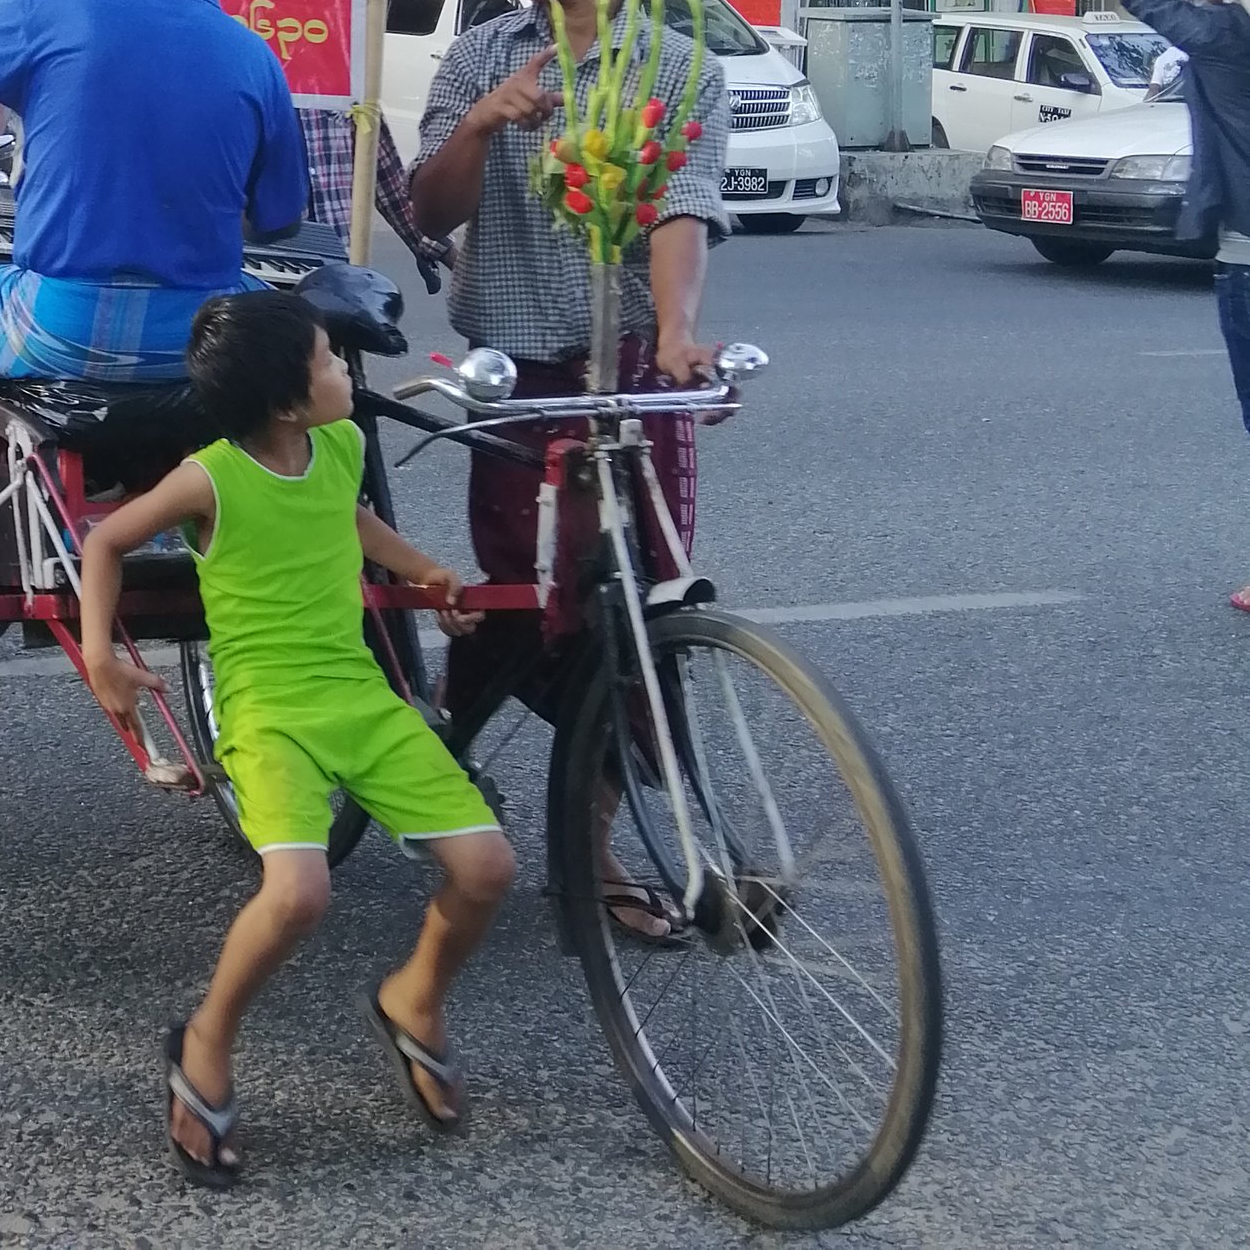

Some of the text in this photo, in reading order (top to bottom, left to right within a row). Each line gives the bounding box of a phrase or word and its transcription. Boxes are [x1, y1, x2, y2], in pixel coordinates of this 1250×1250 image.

[734, 169, 751, 177] YGN
[720, 176, 765, 191] 2J-3982
[1038, 192, 1057, 202] YGN
[1024, 200, 1069, 221] BB-2556
